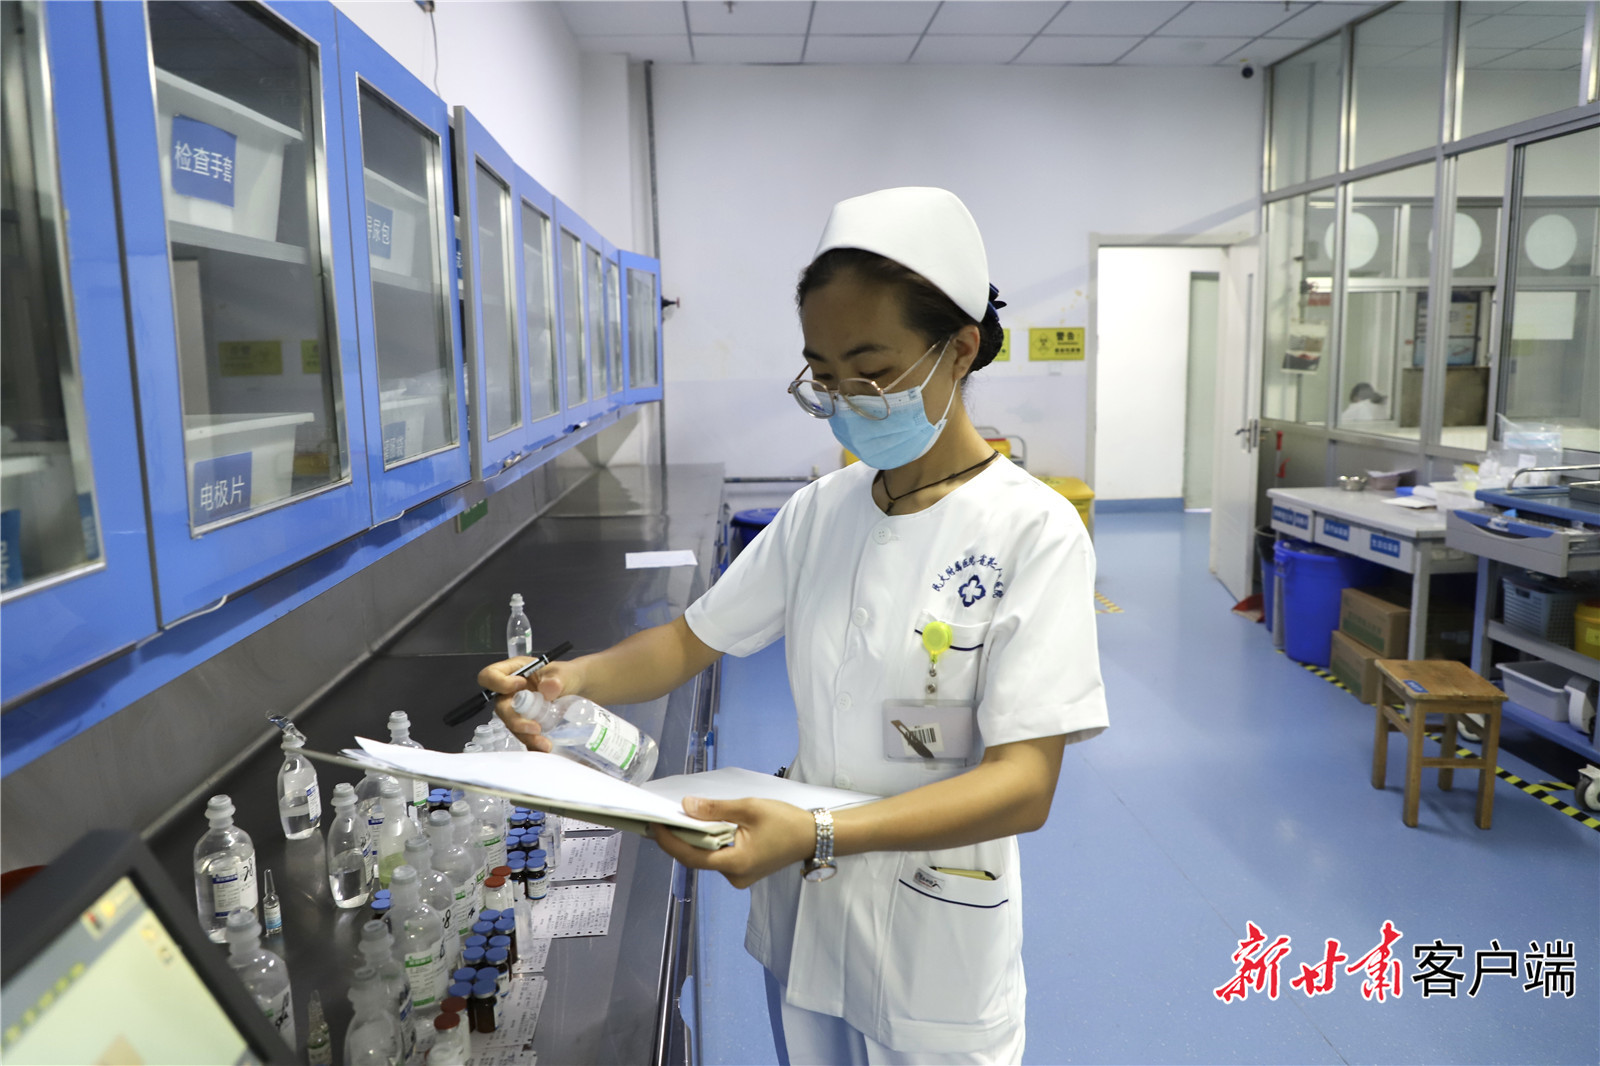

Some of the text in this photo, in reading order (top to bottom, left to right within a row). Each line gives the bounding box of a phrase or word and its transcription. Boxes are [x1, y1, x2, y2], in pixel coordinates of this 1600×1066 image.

[174, 141, 232, 183] 检查手套
[200, 475, 245, 511] 电极片
